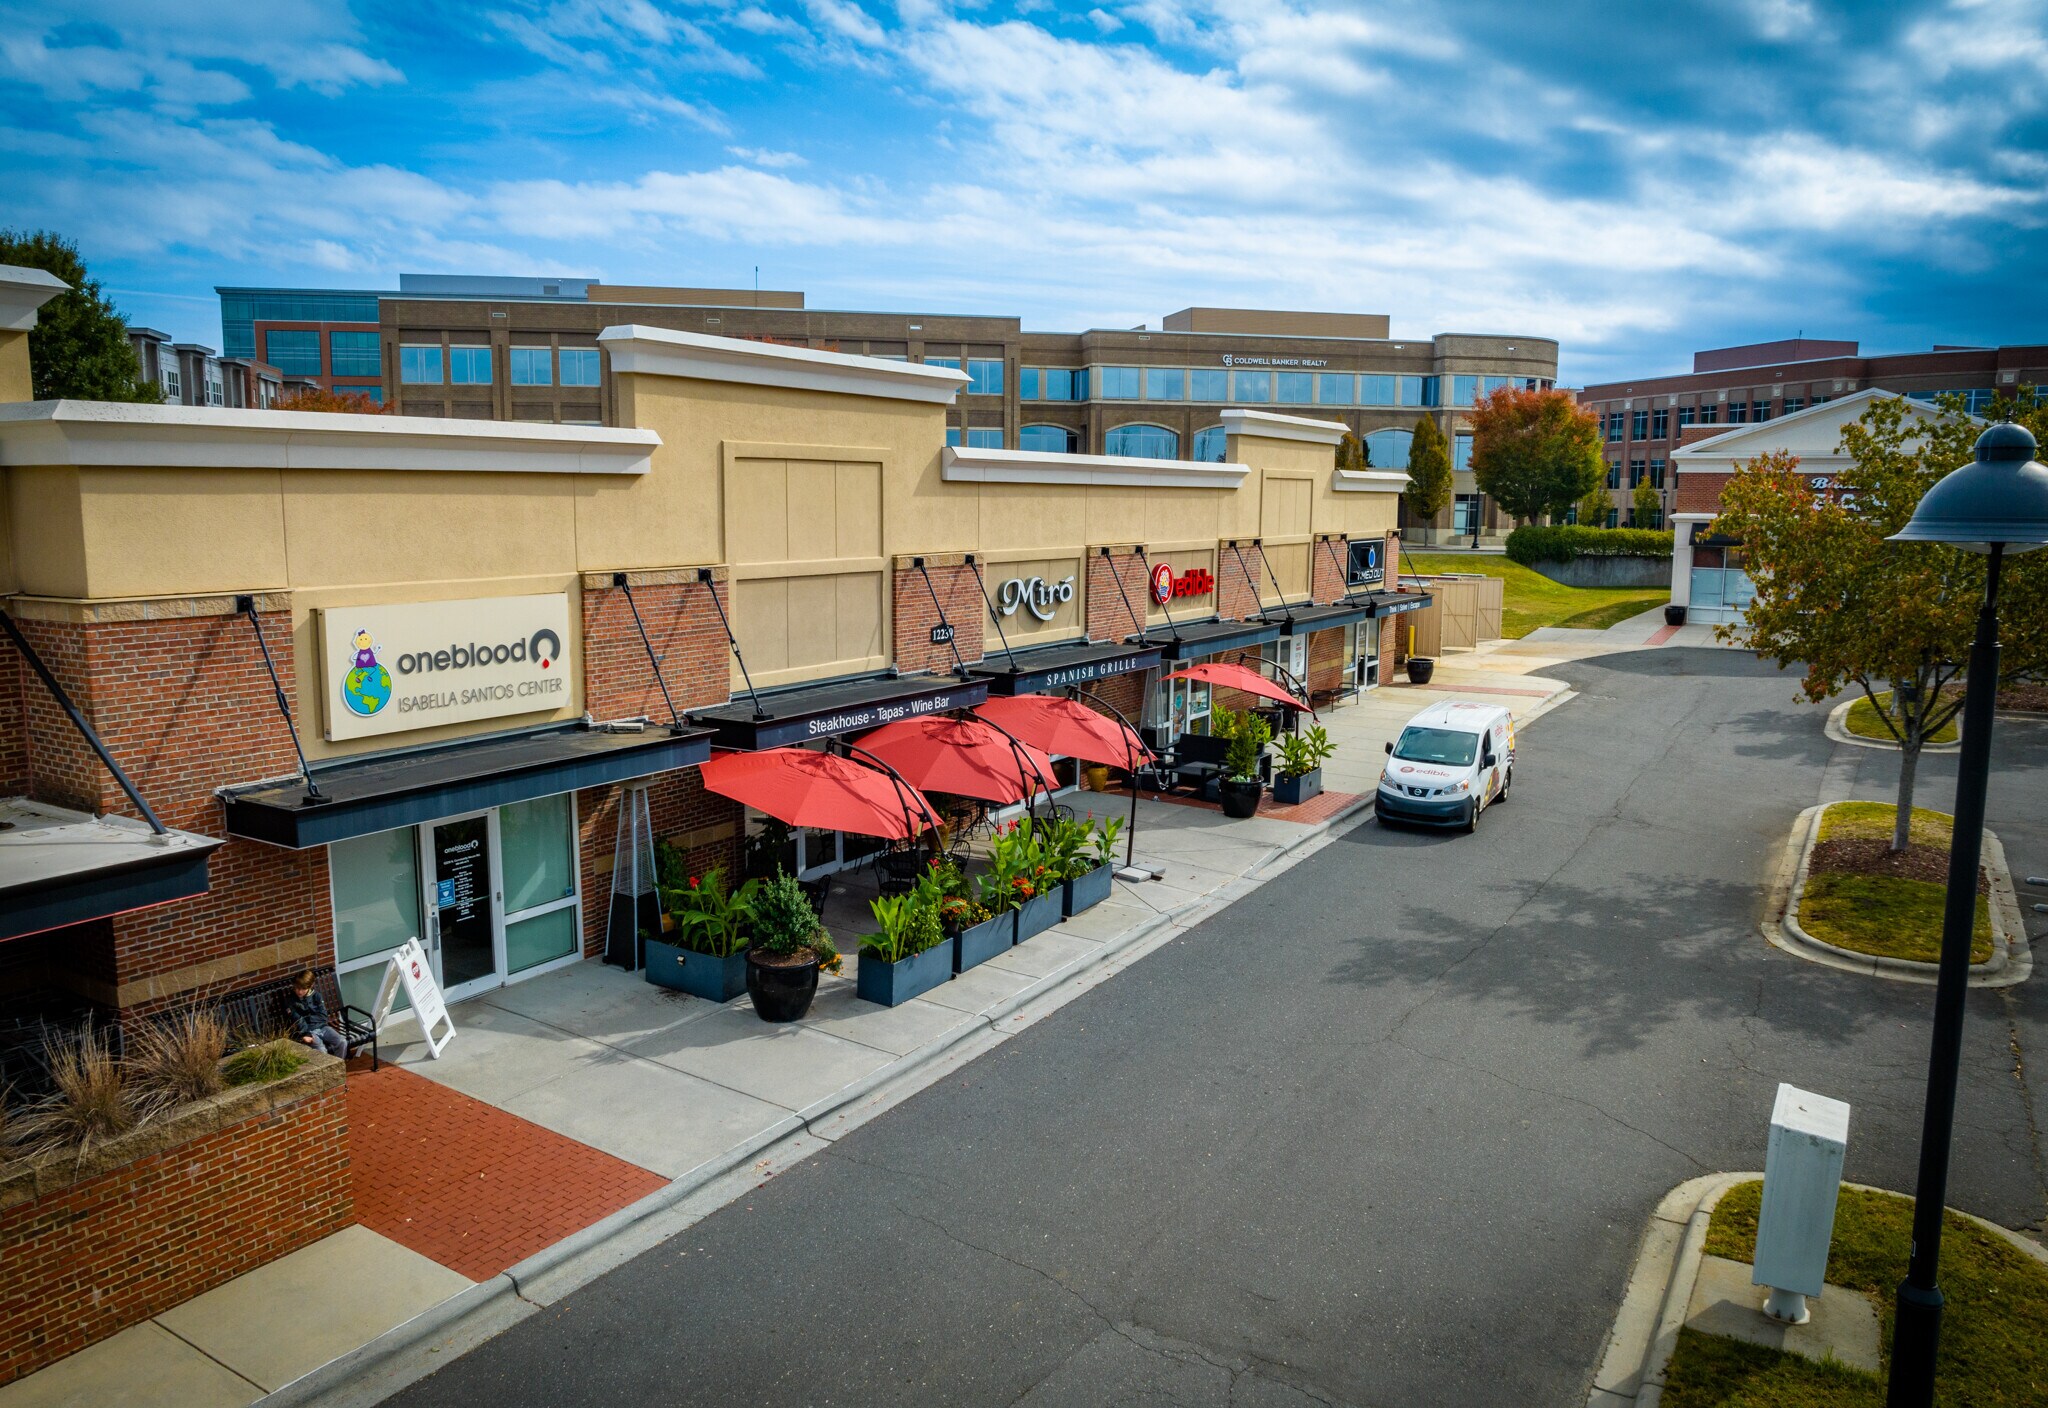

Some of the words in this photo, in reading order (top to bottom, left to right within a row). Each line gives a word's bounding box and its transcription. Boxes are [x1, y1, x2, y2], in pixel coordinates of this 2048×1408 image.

[1234, 357, 1270, 365] COLDWELL
[1272, 358, 1298, 366] BANKER
[1302, 359, 1328, 367] REALTY
[999, 575, 1075, 621] Miró
[1174, 568, 1215, 598] edible
[397, 638, 527, 675] oneblood
[1046, 665, 1094, 686] SPANISH
[1100, 658, 1137, 675] GRILLE
[397, 691, 458, 714] ISABELLA
[460, 684, 514, 705] SANTOS
[516, 677, 562, 698] CENTER
[808, 712, 870, 735] Steakhouse
[876, 705, 904, 722] Tapas
[911, 700, 933, 713] Wine
[934, 696, 950, 709] Bar
[1416, 768, 1451, 778] edible
